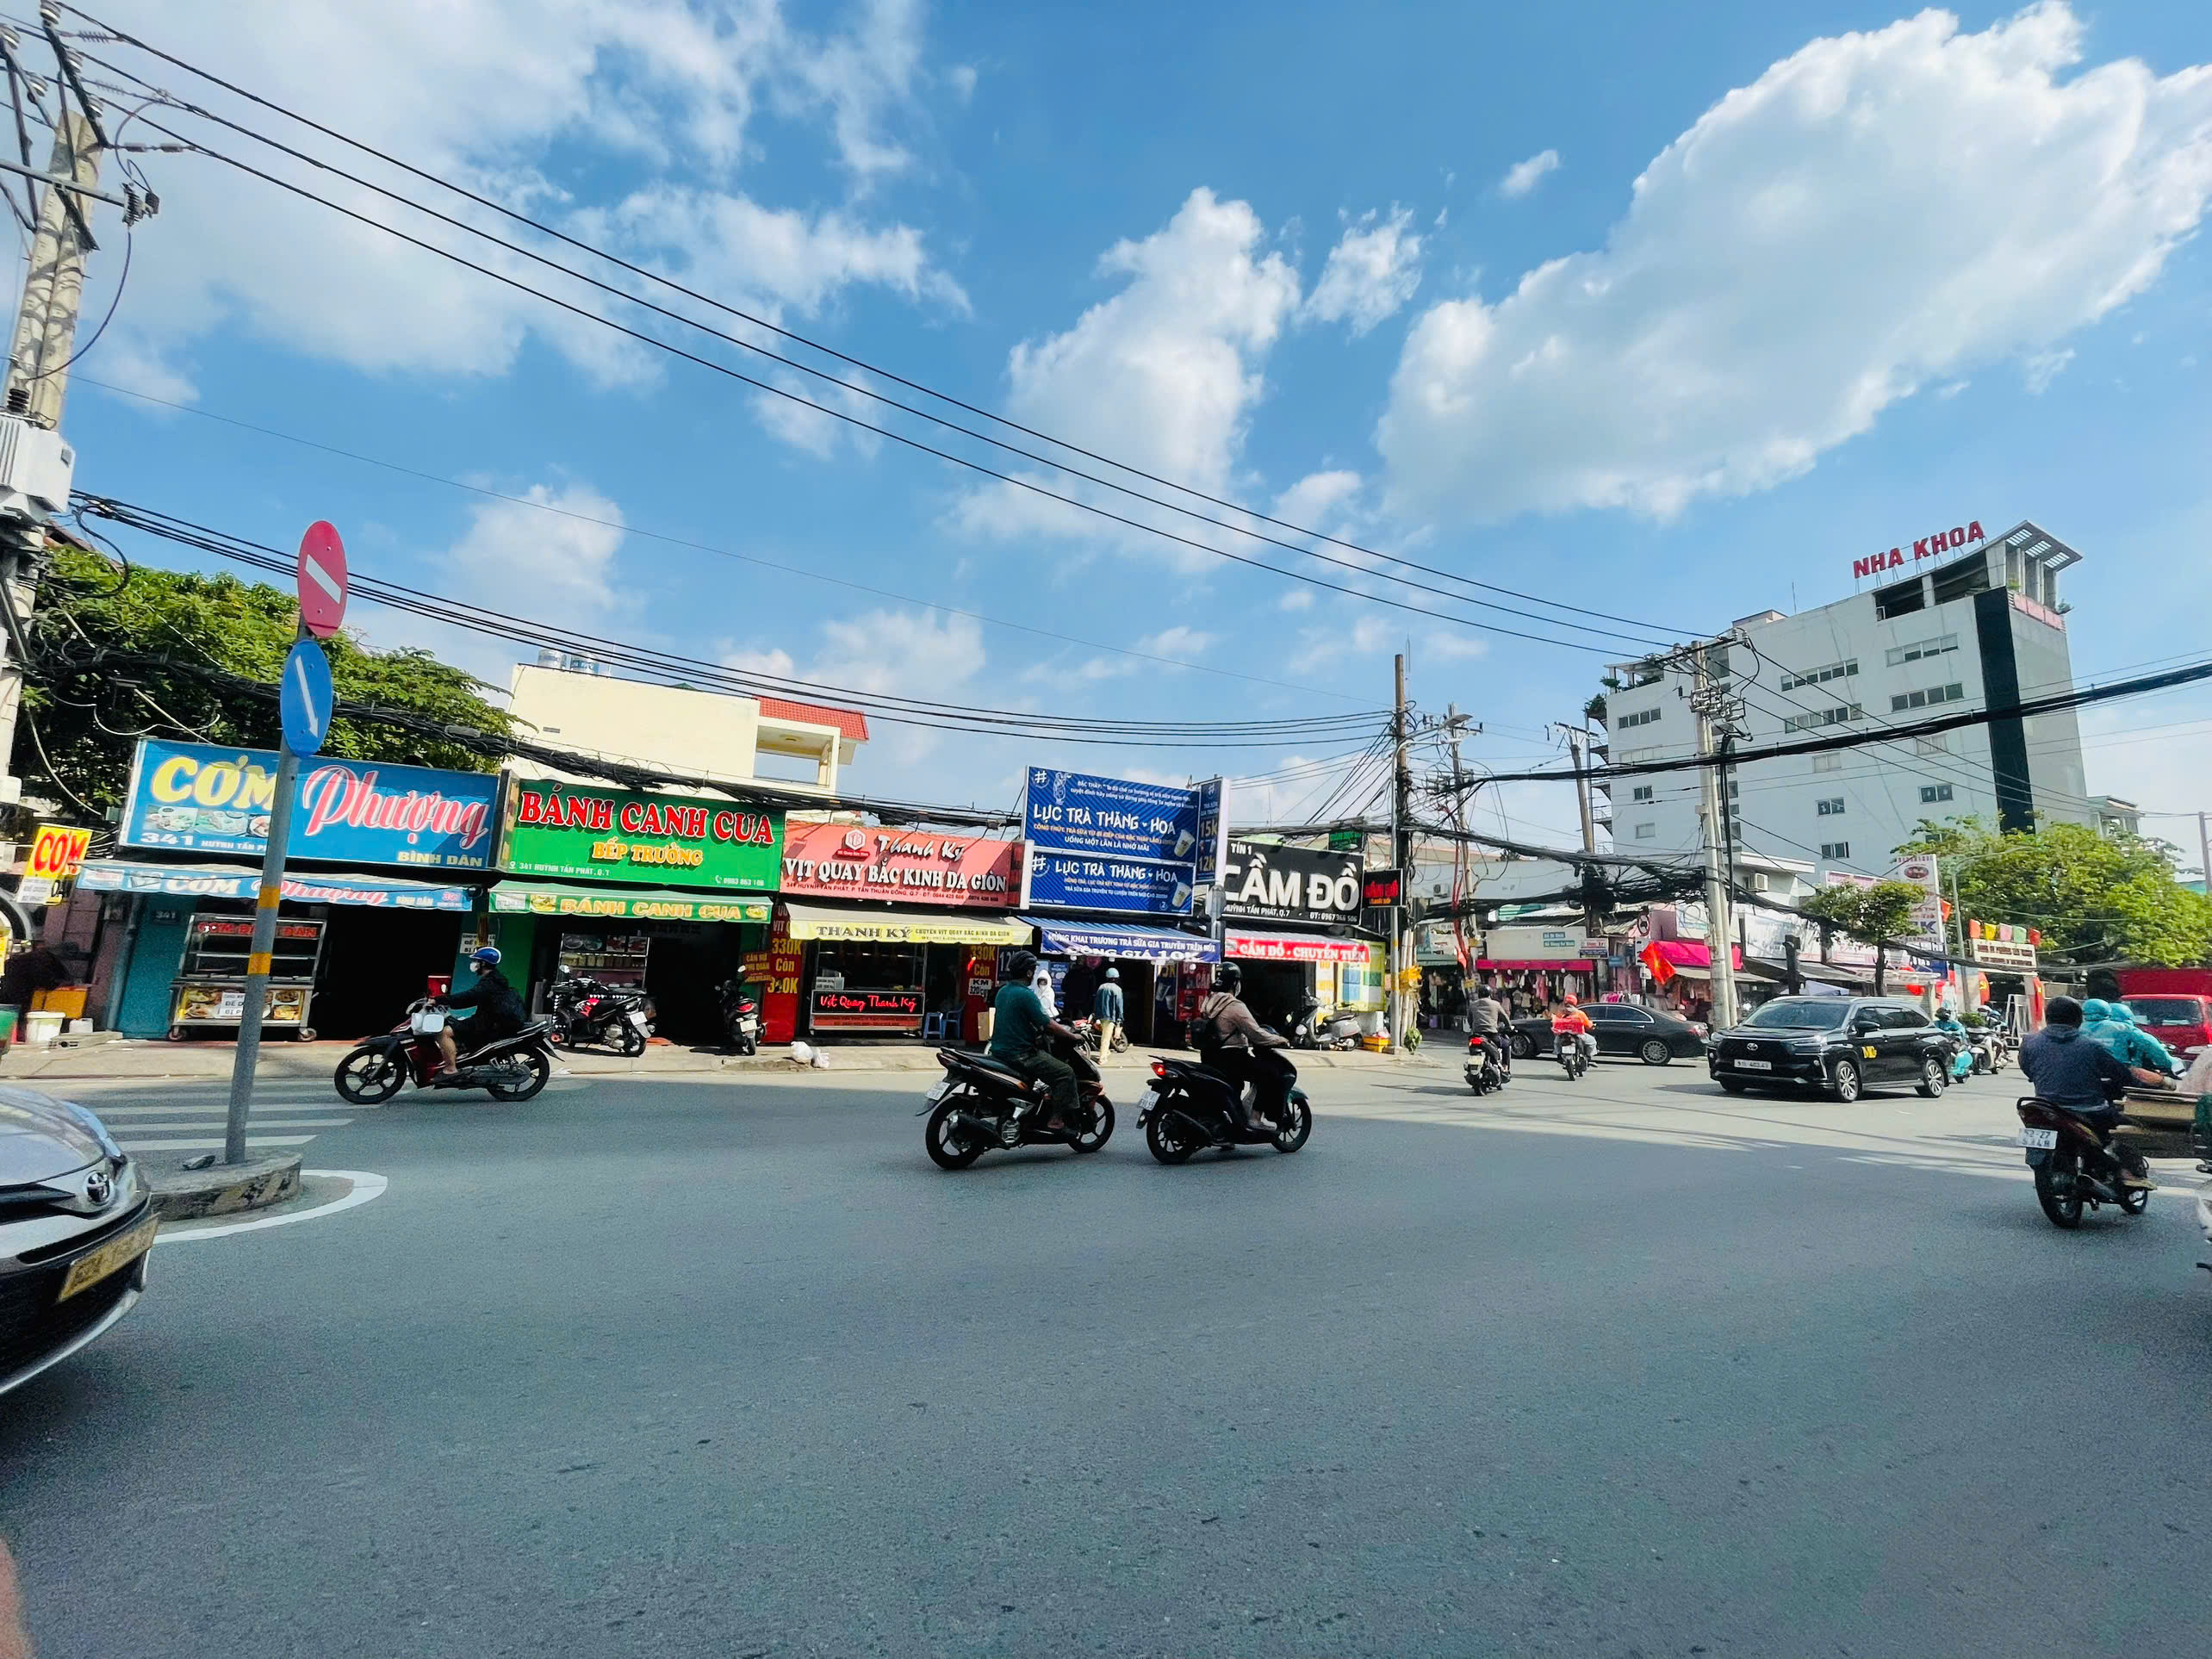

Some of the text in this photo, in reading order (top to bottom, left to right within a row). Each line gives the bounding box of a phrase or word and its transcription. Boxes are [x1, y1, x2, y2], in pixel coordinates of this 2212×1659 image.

[1853, 520, 1985, 579] NHA KHOA
[302, 765, 490, 850] Phượng
[518, 783, 775, 845] BÁNH CANH CUA
[1034, 803, 1177, 836] LỤC TRÀ THĂNG HOA
[140, 832, 194, 845] 341
[878, 835, 935, 857] Thanh
[592, 836, 704, 866] BẾP TRƯỞNG
[784, 857, 1007, 892] VỊT QUAY BẮC KINH DA GIÒN
[1054, 861, 1178, 883] LỤC TRÀ THĂNG HOA
[1306, 861, 1360, 911] ĐỒ
[560, 898, 742, 919] BÁNH CANH CUA
[1246, 904, 1259, 915] TẤN
[816, 926, 883, 938] THANH
[1119, 937, 1133, 947] TRÀ
[772, 938, 803, 955] 330K
[1240, 940, 1267, 957] CẦM
[1267, 942, 1285, 958] ĐỒ
